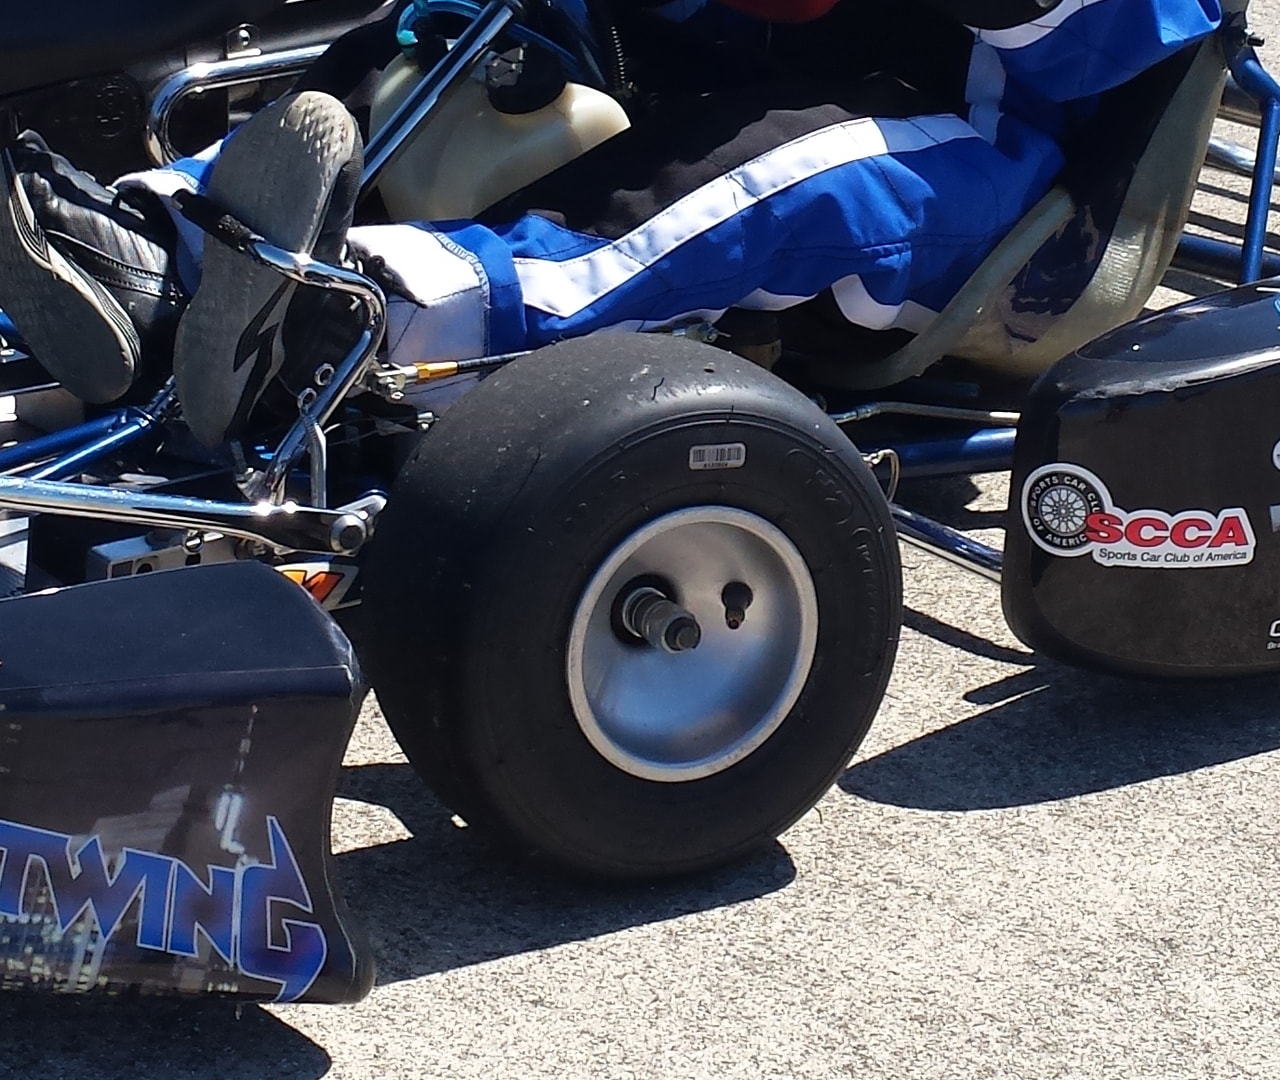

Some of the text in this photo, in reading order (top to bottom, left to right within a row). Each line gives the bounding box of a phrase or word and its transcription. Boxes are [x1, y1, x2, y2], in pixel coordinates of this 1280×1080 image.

[1030, 476, 1102, 514] SPORTS CAR CLU
[1033, 518, 1088, 547] OF AMERIC
[1084, 512, 1250, 549] SCCA
[1098, 548, 1248, 563] Sports Car Club of America
